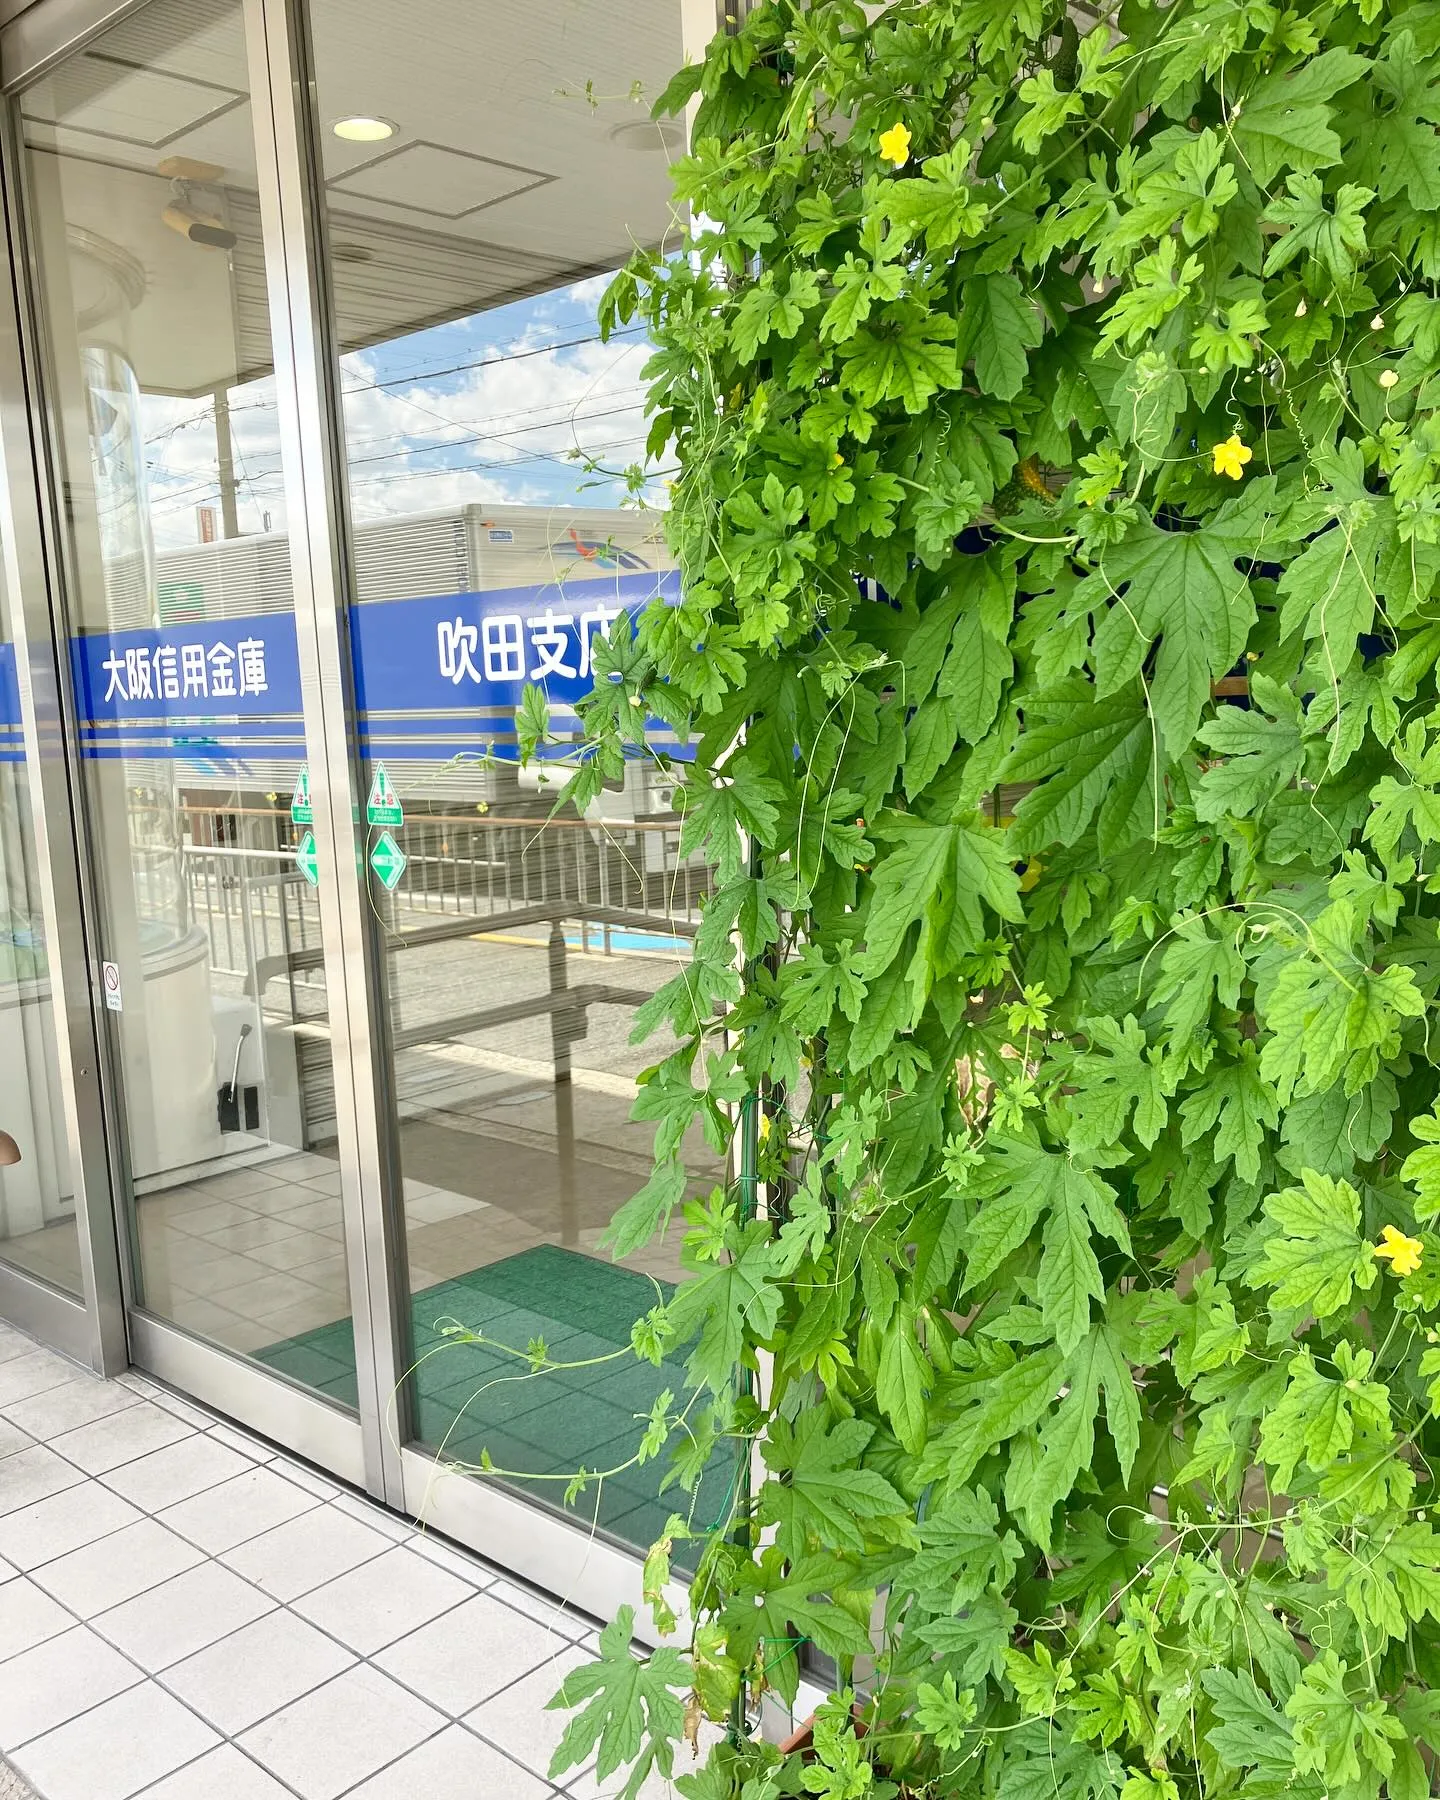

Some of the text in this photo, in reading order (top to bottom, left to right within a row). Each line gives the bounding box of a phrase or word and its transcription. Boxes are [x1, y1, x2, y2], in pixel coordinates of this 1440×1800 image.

[102, 636, 269, 702] 大阪信用金庫
